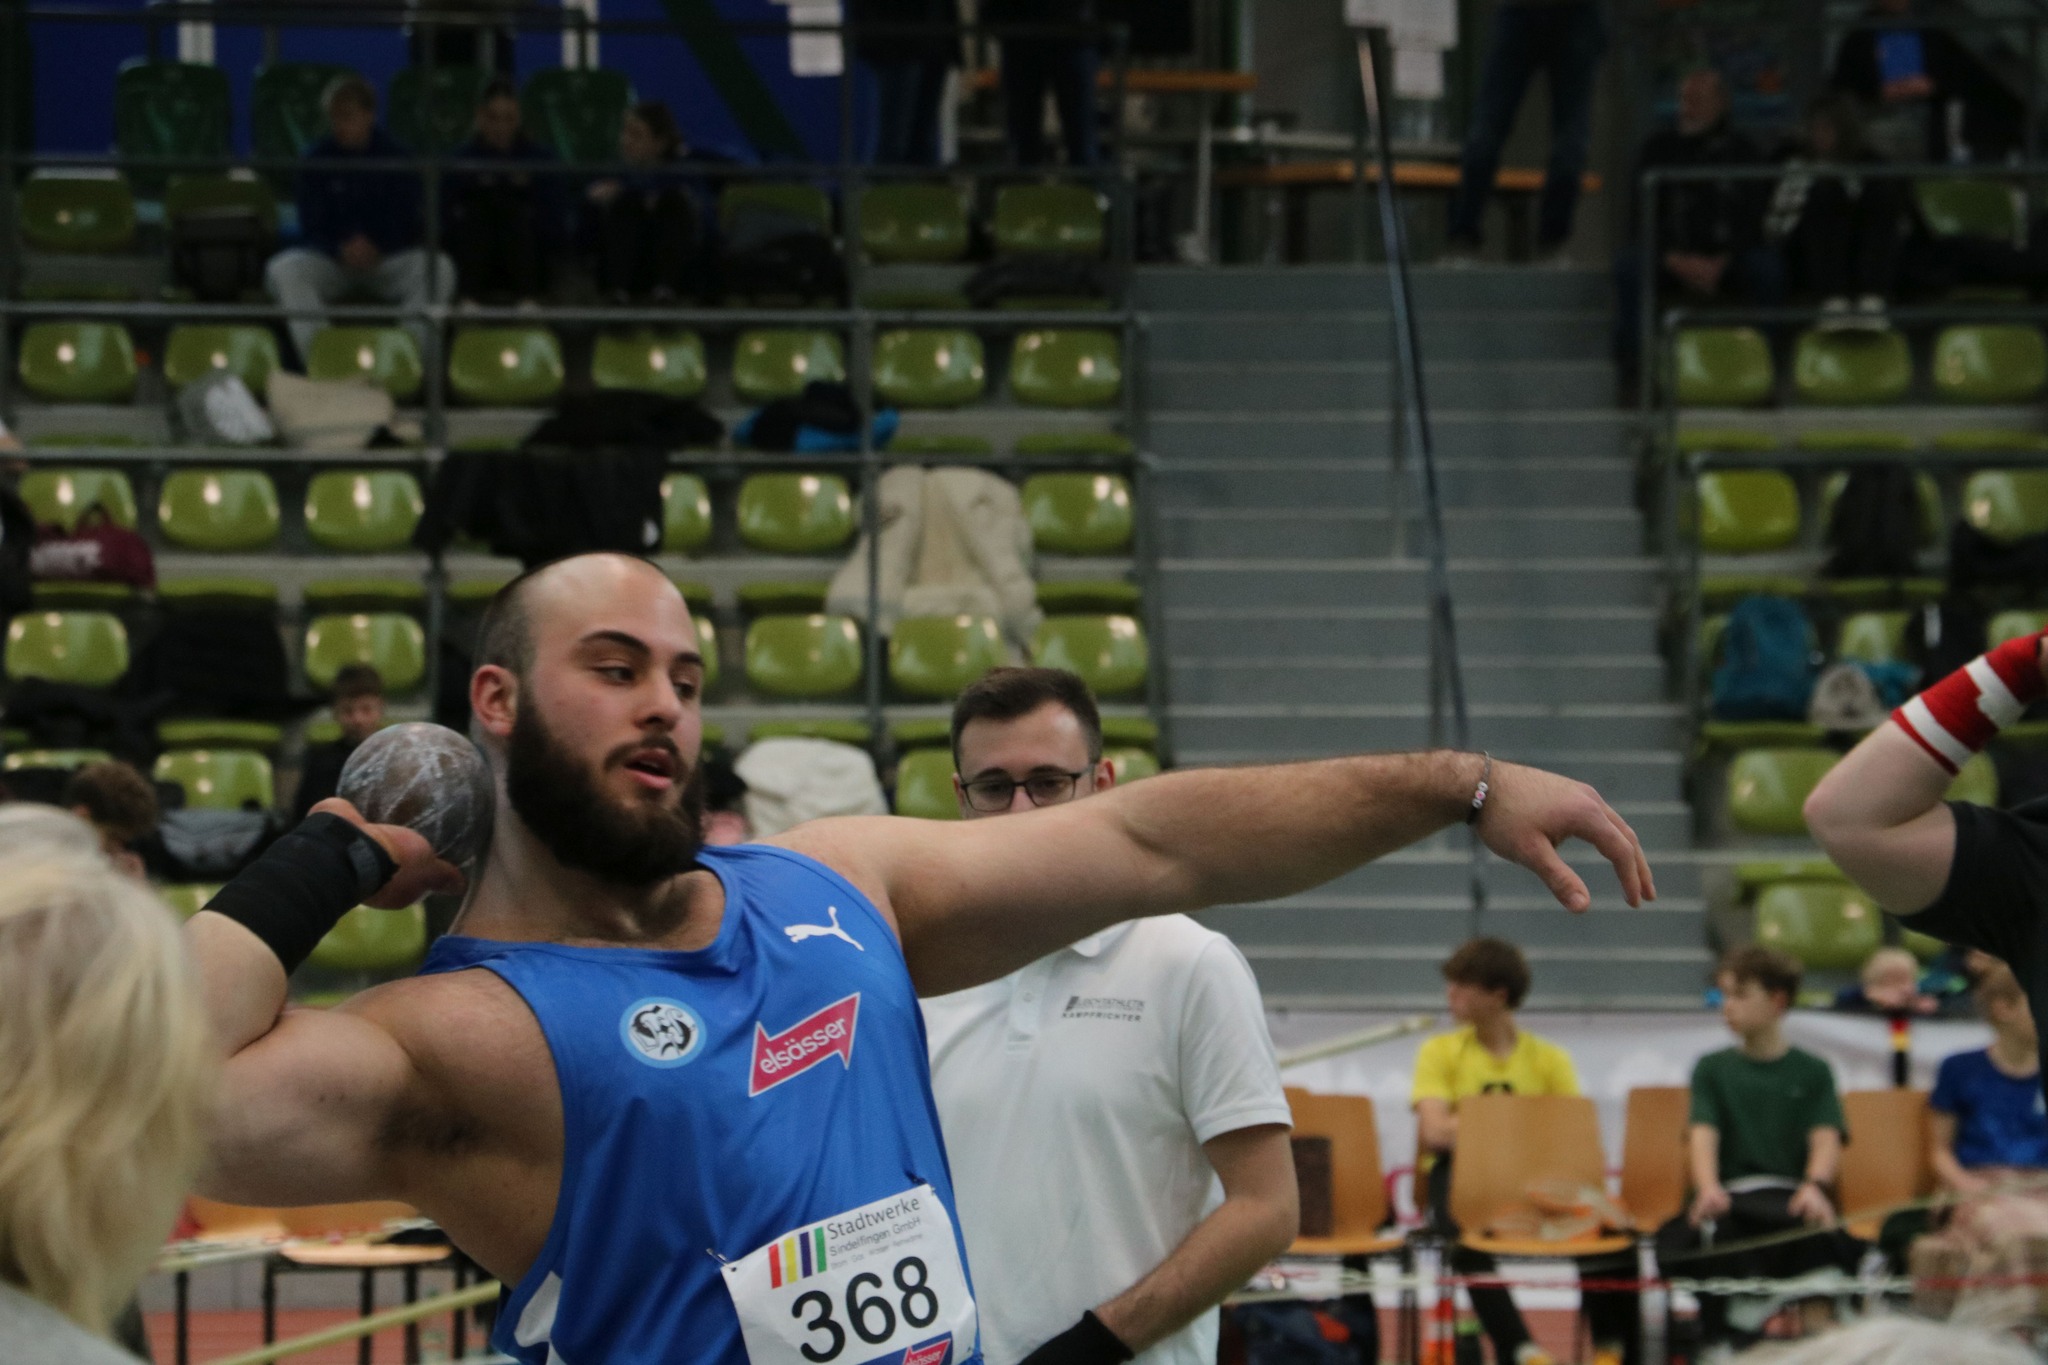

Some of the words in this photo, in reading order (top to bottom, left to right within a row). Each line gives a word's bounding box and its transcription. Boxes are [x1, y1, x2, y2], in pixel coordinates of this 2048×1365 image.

[1062, 1011, 1142, 1023] KAMPFRICHTER
[759, 1015, 848, 1075] elsässer
[826, 1197, 921, 1240] Stadtwerke
[829, 1229, 891, 1257] Sindelfingen
[892, 1216, 921, 1234] GmbH
[791, 1256, 939, 1363] 368
